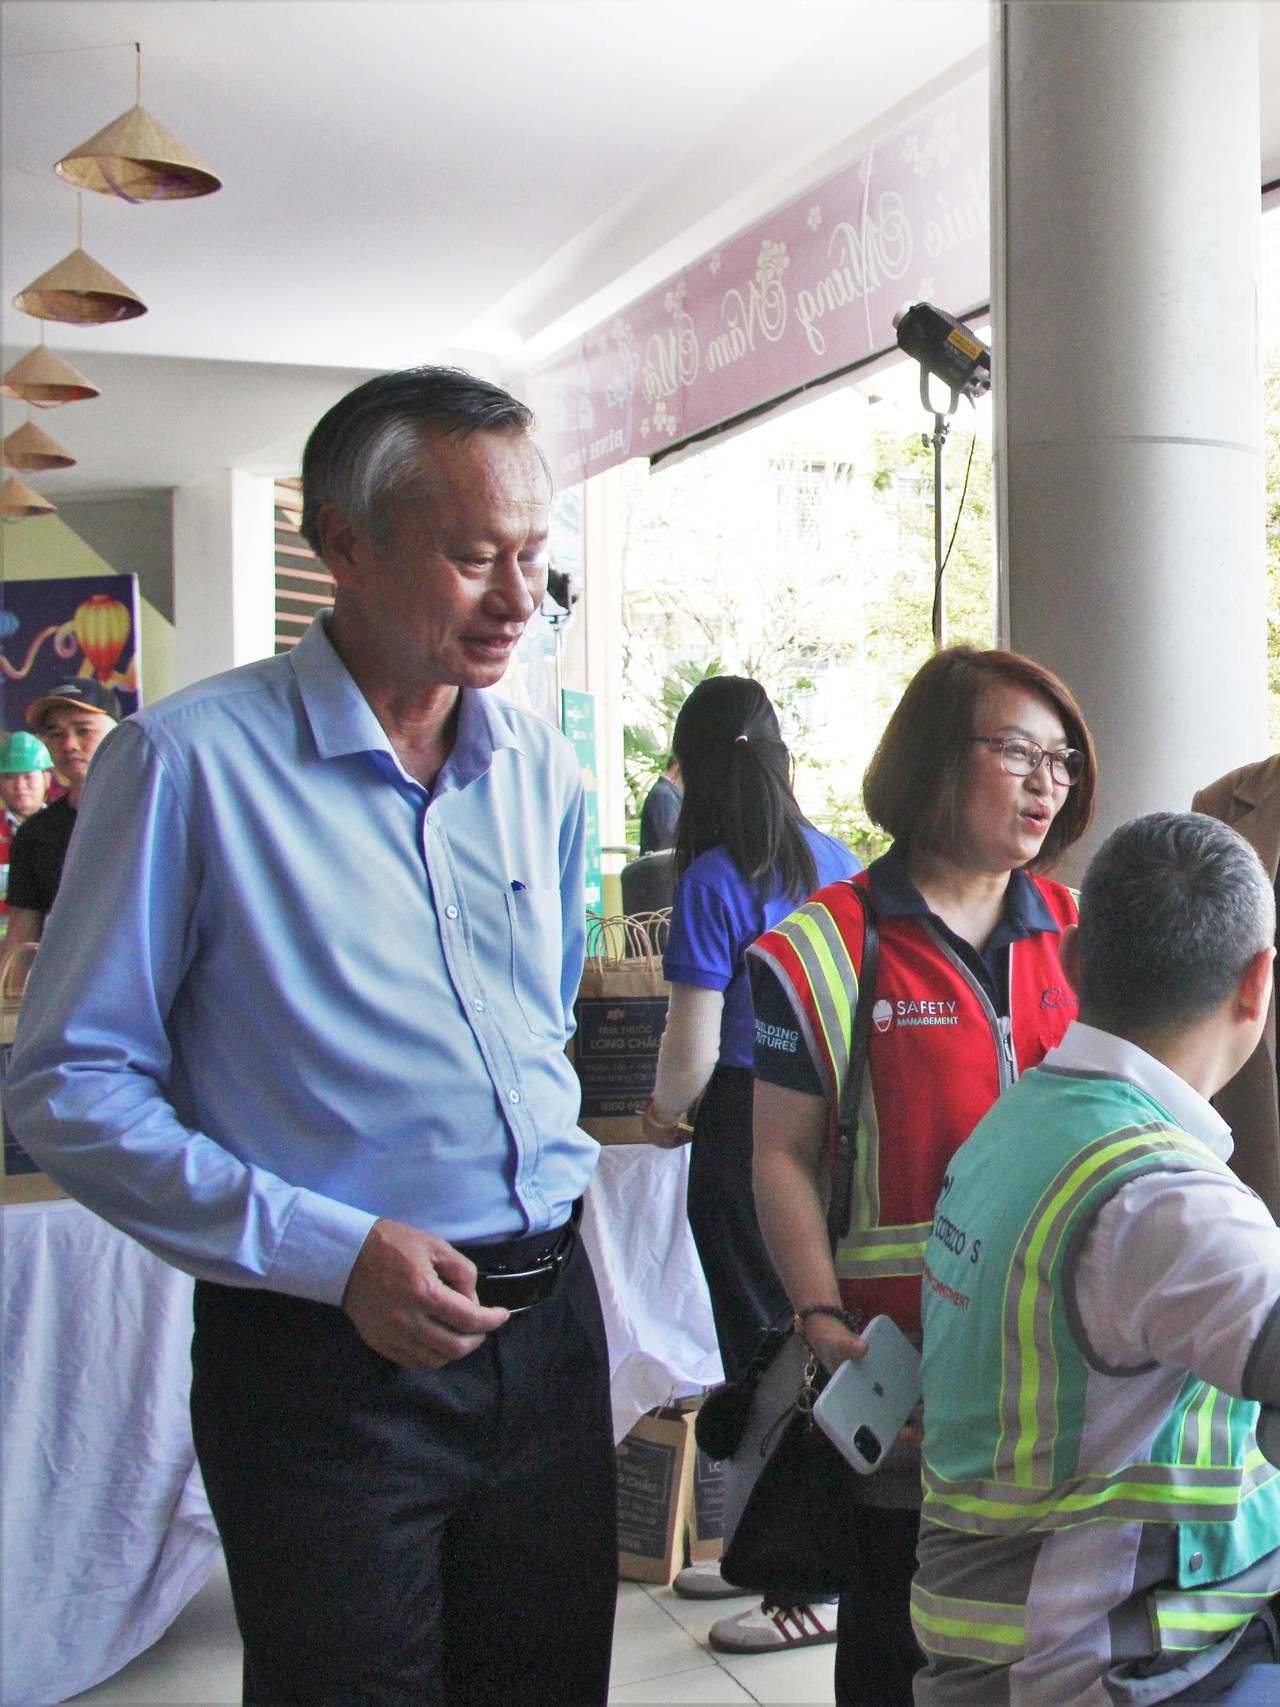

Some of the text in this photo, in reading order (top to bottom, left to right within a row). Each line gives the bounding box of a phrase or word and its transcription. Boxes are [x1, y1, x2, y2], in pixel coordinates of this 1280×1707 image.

[897, 1000, 956, 1015] SAFETY
[897, 1016, 959, 1025] MANAGEMENT
[590, 1038, 625, 1050] LONG
[755, 1031, 797, 1053] FUTURES
[626, 1100, 647, 1110] 692
